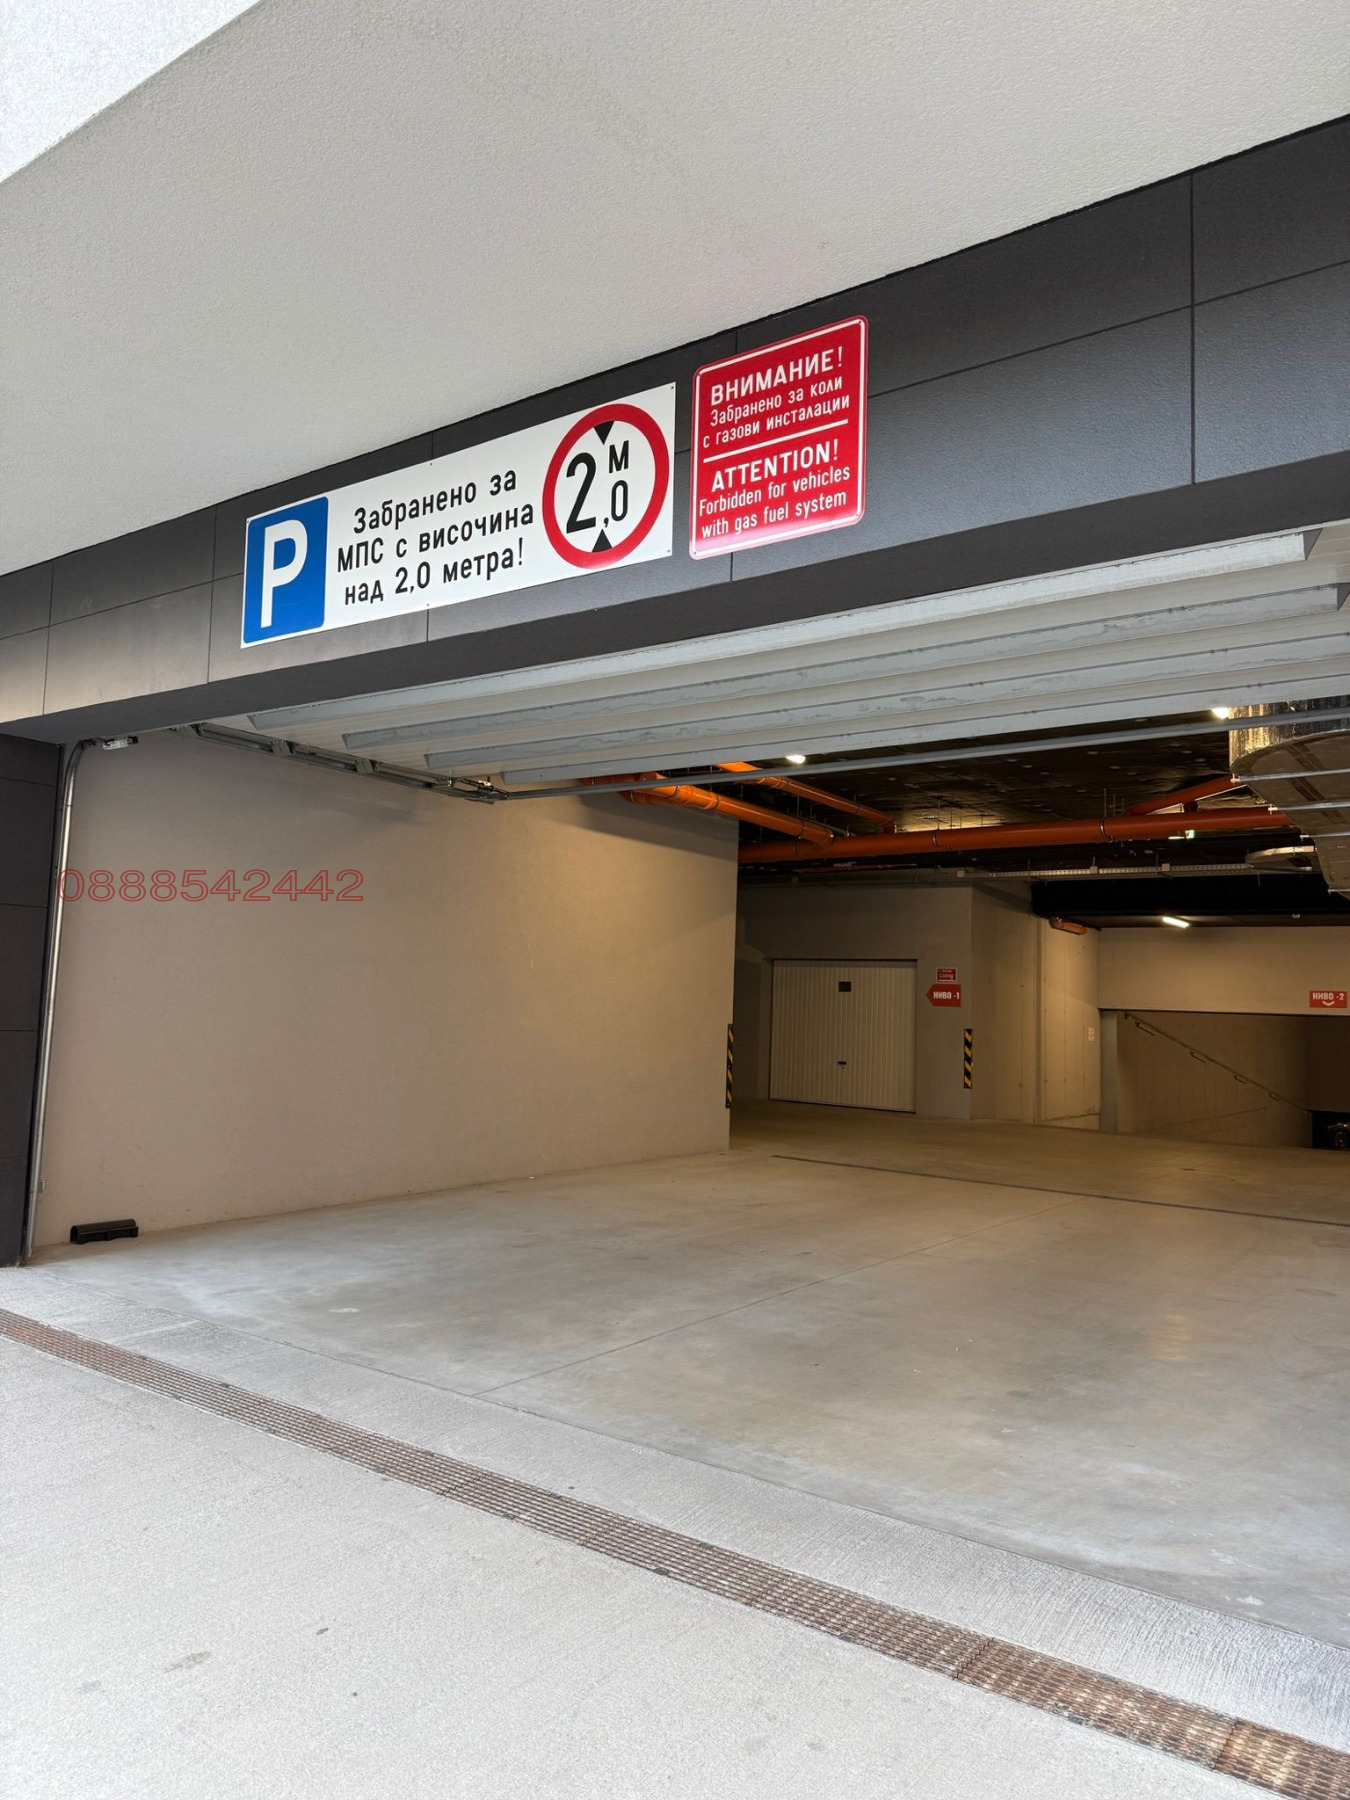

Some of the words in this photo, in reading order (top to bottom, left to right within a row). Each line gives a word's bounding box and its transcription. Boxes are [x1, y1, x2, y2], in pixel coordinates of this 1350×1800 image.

[711, 346, 843, 406] ВНИМАНИЕ!
[711, 394, 782, 427] Забранено
[788, 387, 804, 405] за
[810, 376, 843, 399] коли
[703, 434, 710, 448] с
[716, 423, 760, 445] газови
[766, 395, 850, 430] инсталации
[699, 488, 762, 517] Forbidden
[768, 480, 787, 499] for
[792, 466, 851, 493] vehicles
[711, 439, 839, 492] ATTENTION!
[353, 483, 477, 534] Забранено
[490, 469, 518, 496] за
[702, 518, 729, 539] with
[735, 512, 758, 534] gas
[764, 503, 789, 527] fuel
[795, 491, 847, 519] system
[337, 537, 384, 573] МПС
[396, 538, 407, 558] с
[419, 502, 534, 553] височина
[260, 519, 308, 629] P
[344, 578, 384, 606] над
[395, 566, 431, 596] 2,0
[443, 537, 524, 585] метра!
[933, 991, 952, 999] НИВО
[1312, 992, 1334, 1000] НИВО
[1336, 992, 1345, 1000] -2
